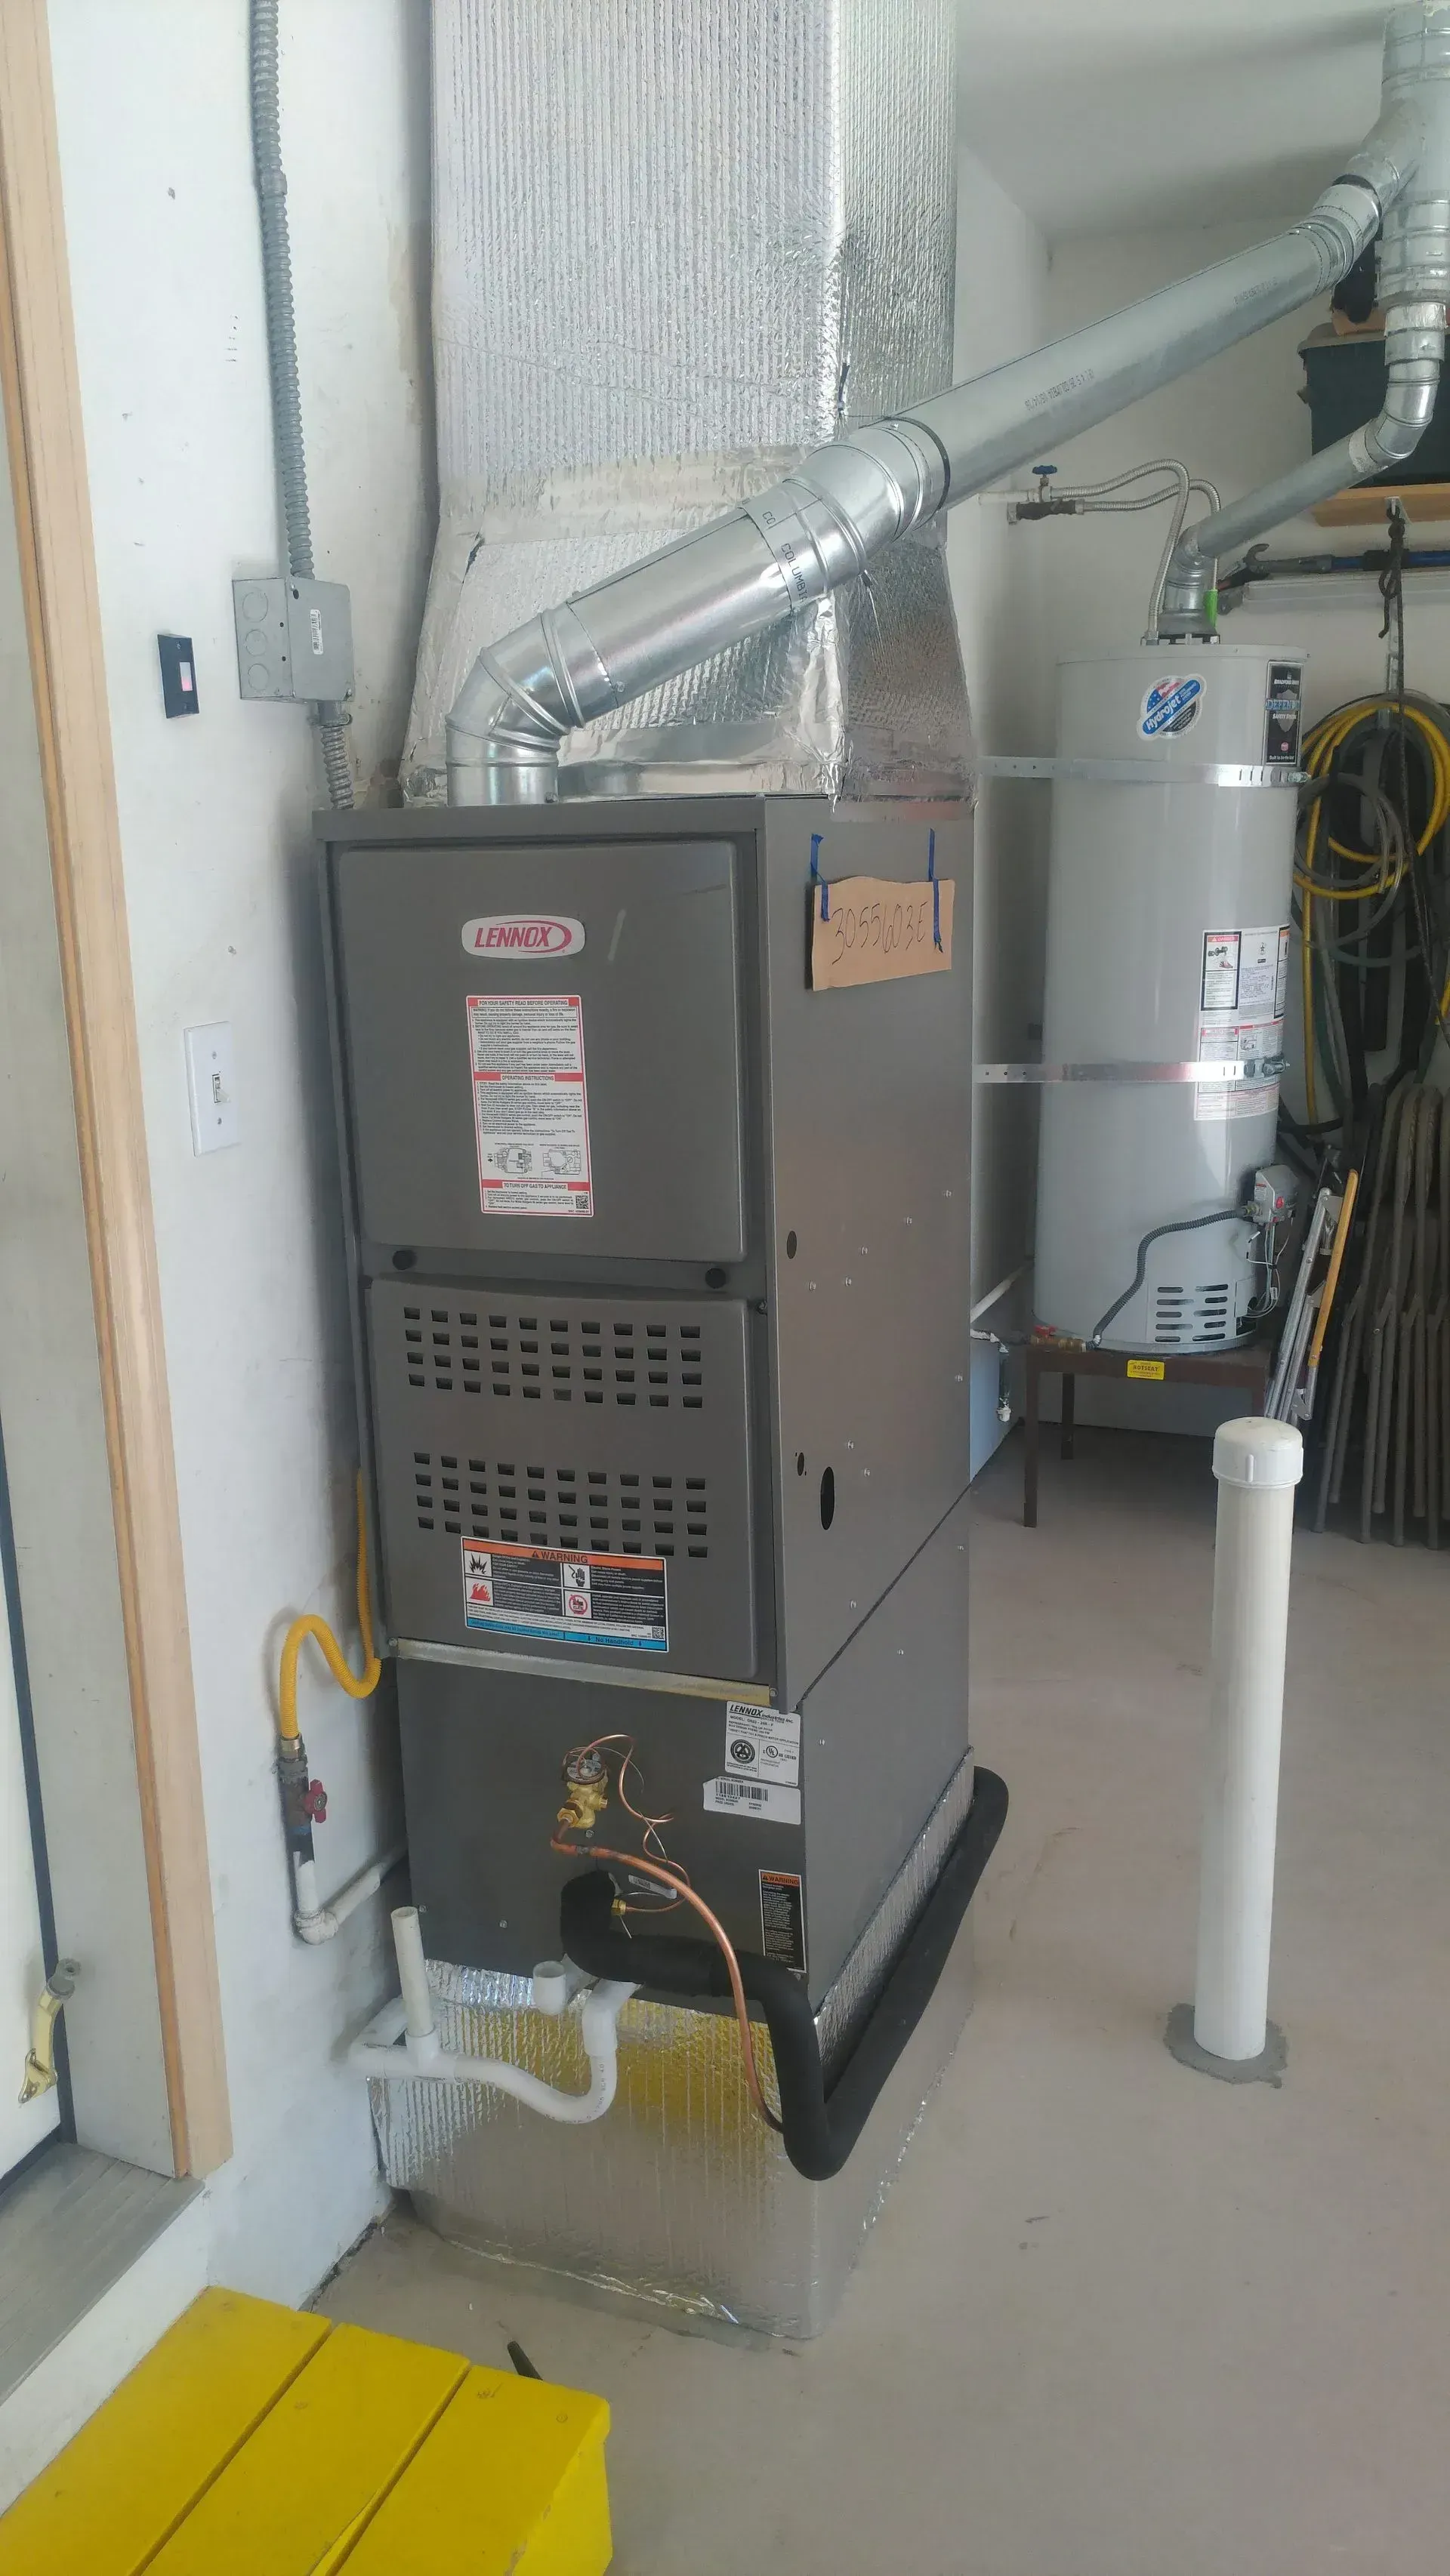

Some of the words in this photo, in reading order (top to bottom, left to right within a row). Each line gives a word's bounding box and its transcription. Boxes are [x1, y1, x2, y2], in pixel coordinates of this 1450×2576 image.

[1146, 695, 1181, 730] Hydrojet
[474, 926, 553, 948] LENNOX
[541, 1551, 588, 1563] WARNING
[605, 1638, 634, 1646] Handhold
[730, 1704, 764, 1717] LENNOX
[769, 1875, 798, 1885] WARNING
